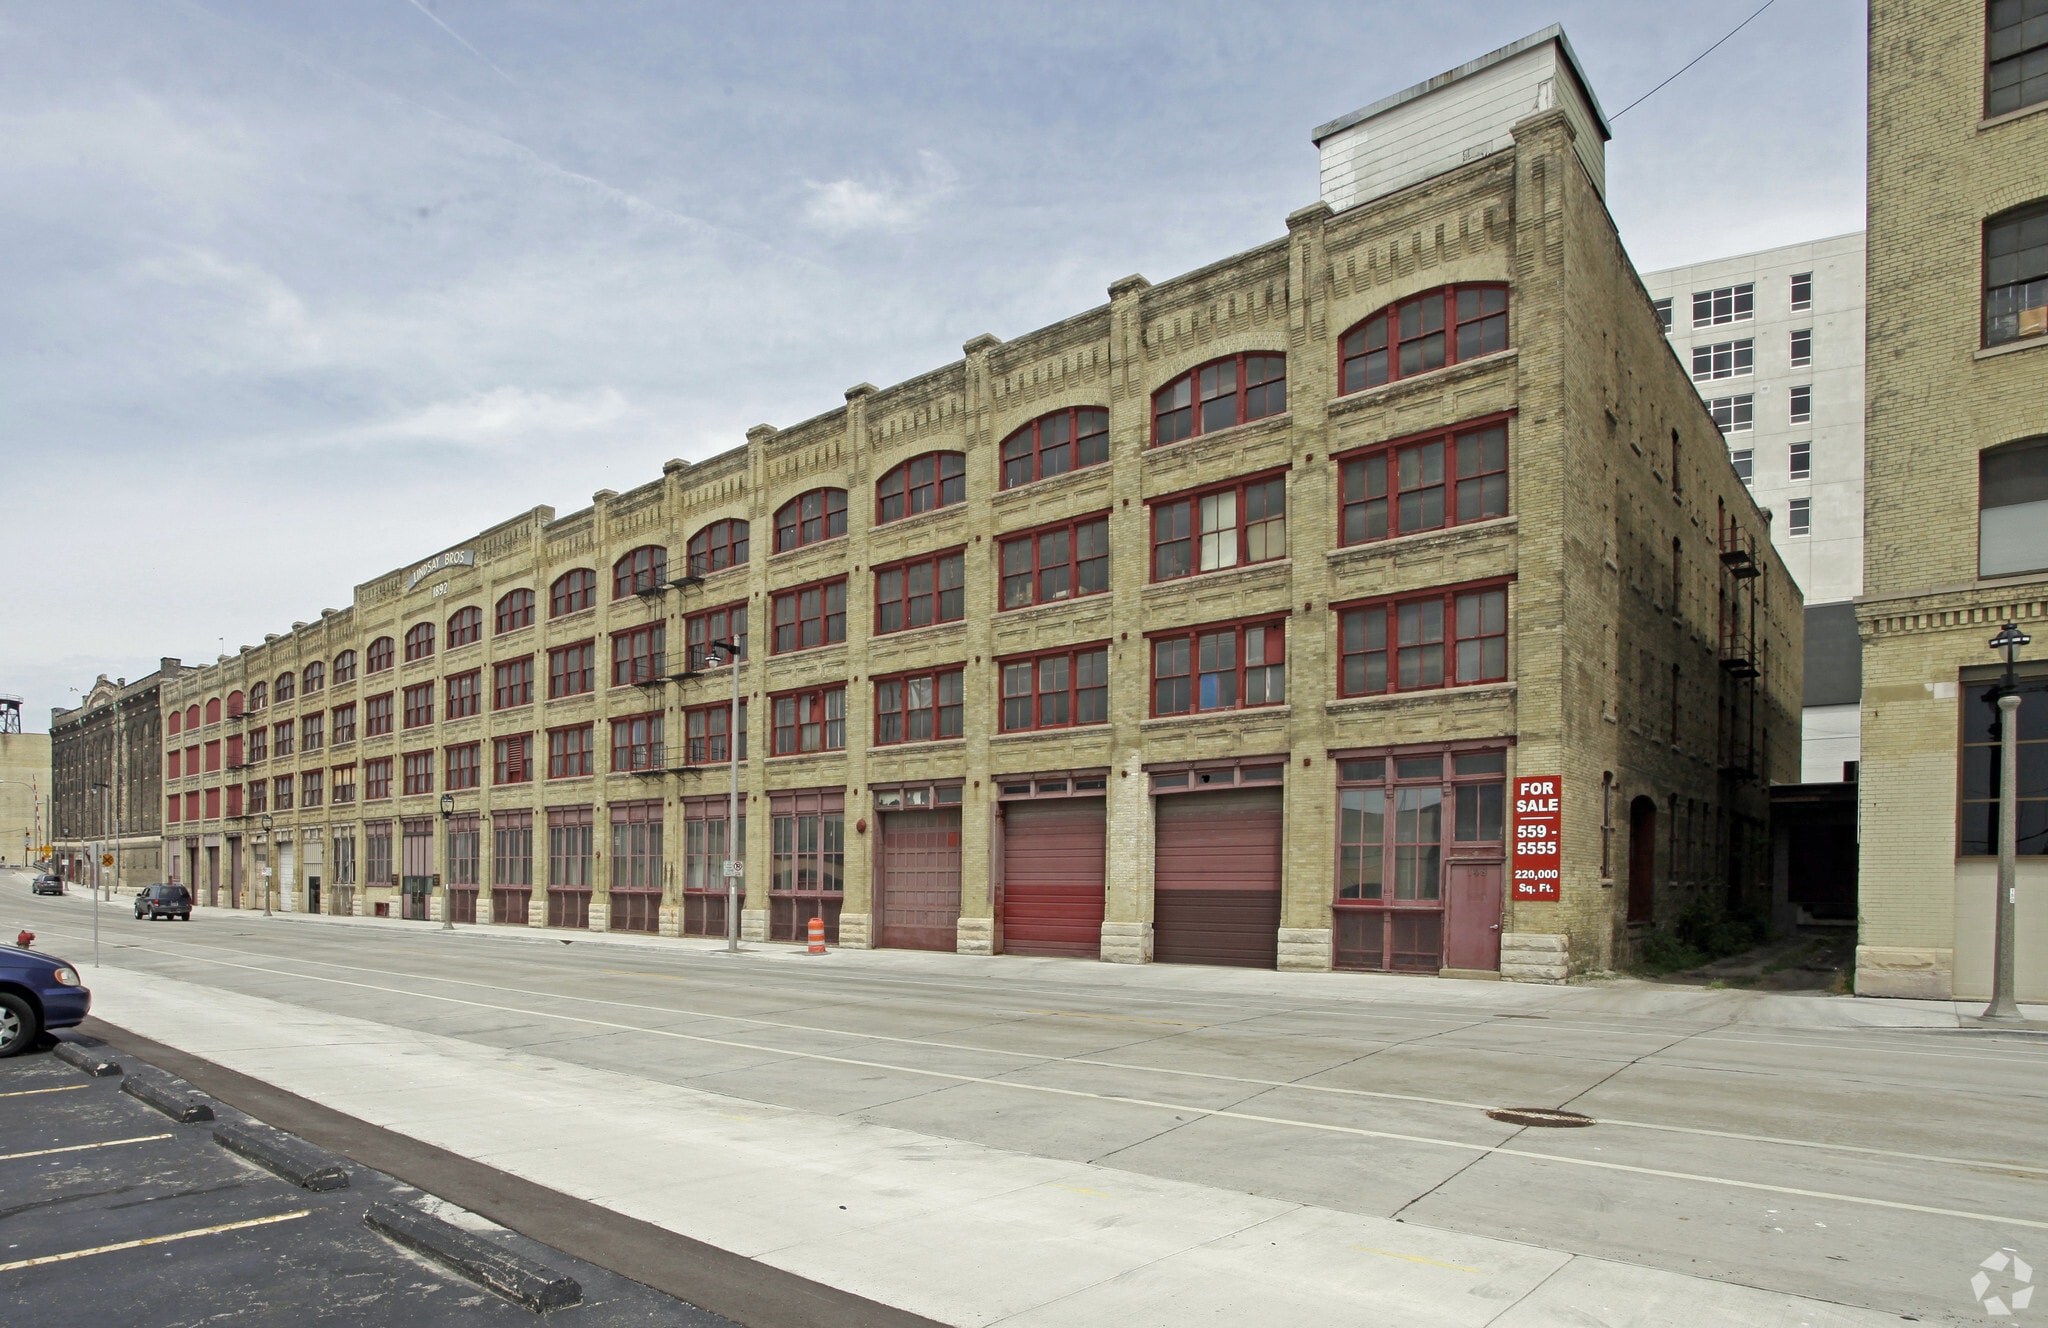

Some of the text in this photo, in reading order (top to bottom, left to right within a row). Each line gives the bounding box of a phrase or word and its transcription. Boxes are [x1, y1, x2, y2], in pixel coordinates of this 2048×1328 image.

[413, 550, 465, 583] LINDSAY BROS
[432, 582, 448, 598] 1892
[1520, 782, 1554, 796] FOR
[1516, 798, 1559, 813] SALE
[1517, 824, 1547, 838] 559
[1517, 841, 1557, 855] 5555
[1515, 869, 1558, 880] 220,000
[1519, 883, 1554, 894] Sq. Ft.
